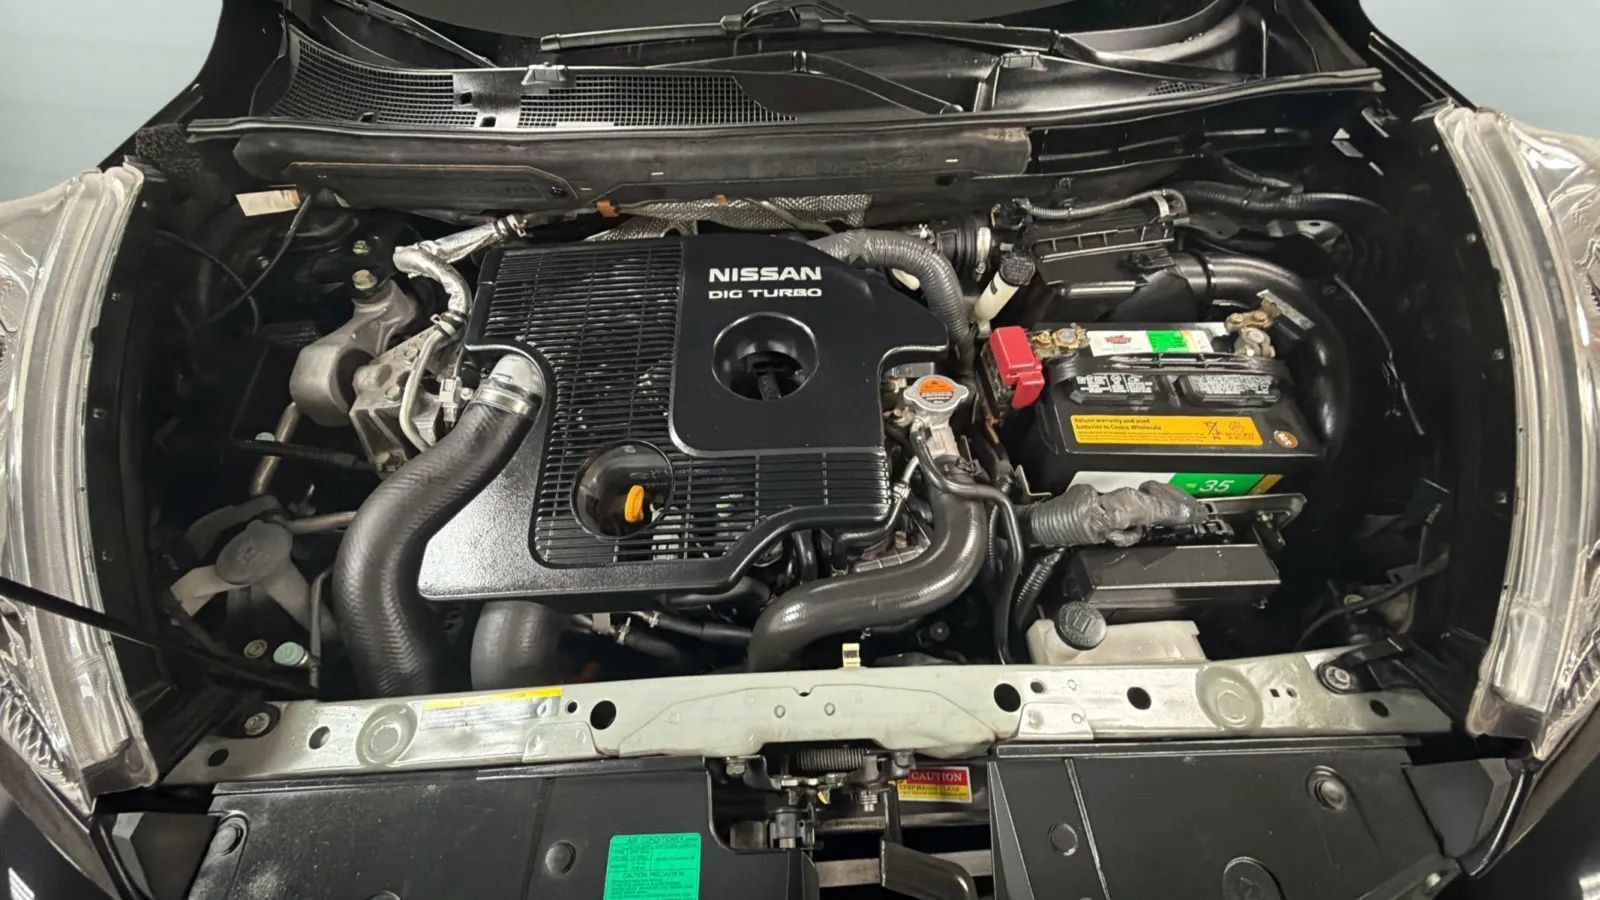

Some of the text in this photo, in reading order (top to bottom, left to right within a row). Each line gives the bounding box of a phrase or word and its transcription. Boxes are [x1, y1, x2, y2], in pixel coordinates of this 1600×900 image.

[708, 266, 822, 283] NISSAN
[708, 288, 822, 299] DIG TURBO
[1199, 479, 1235, 493] 35
[911, 771, 962, 782] CAUTION
